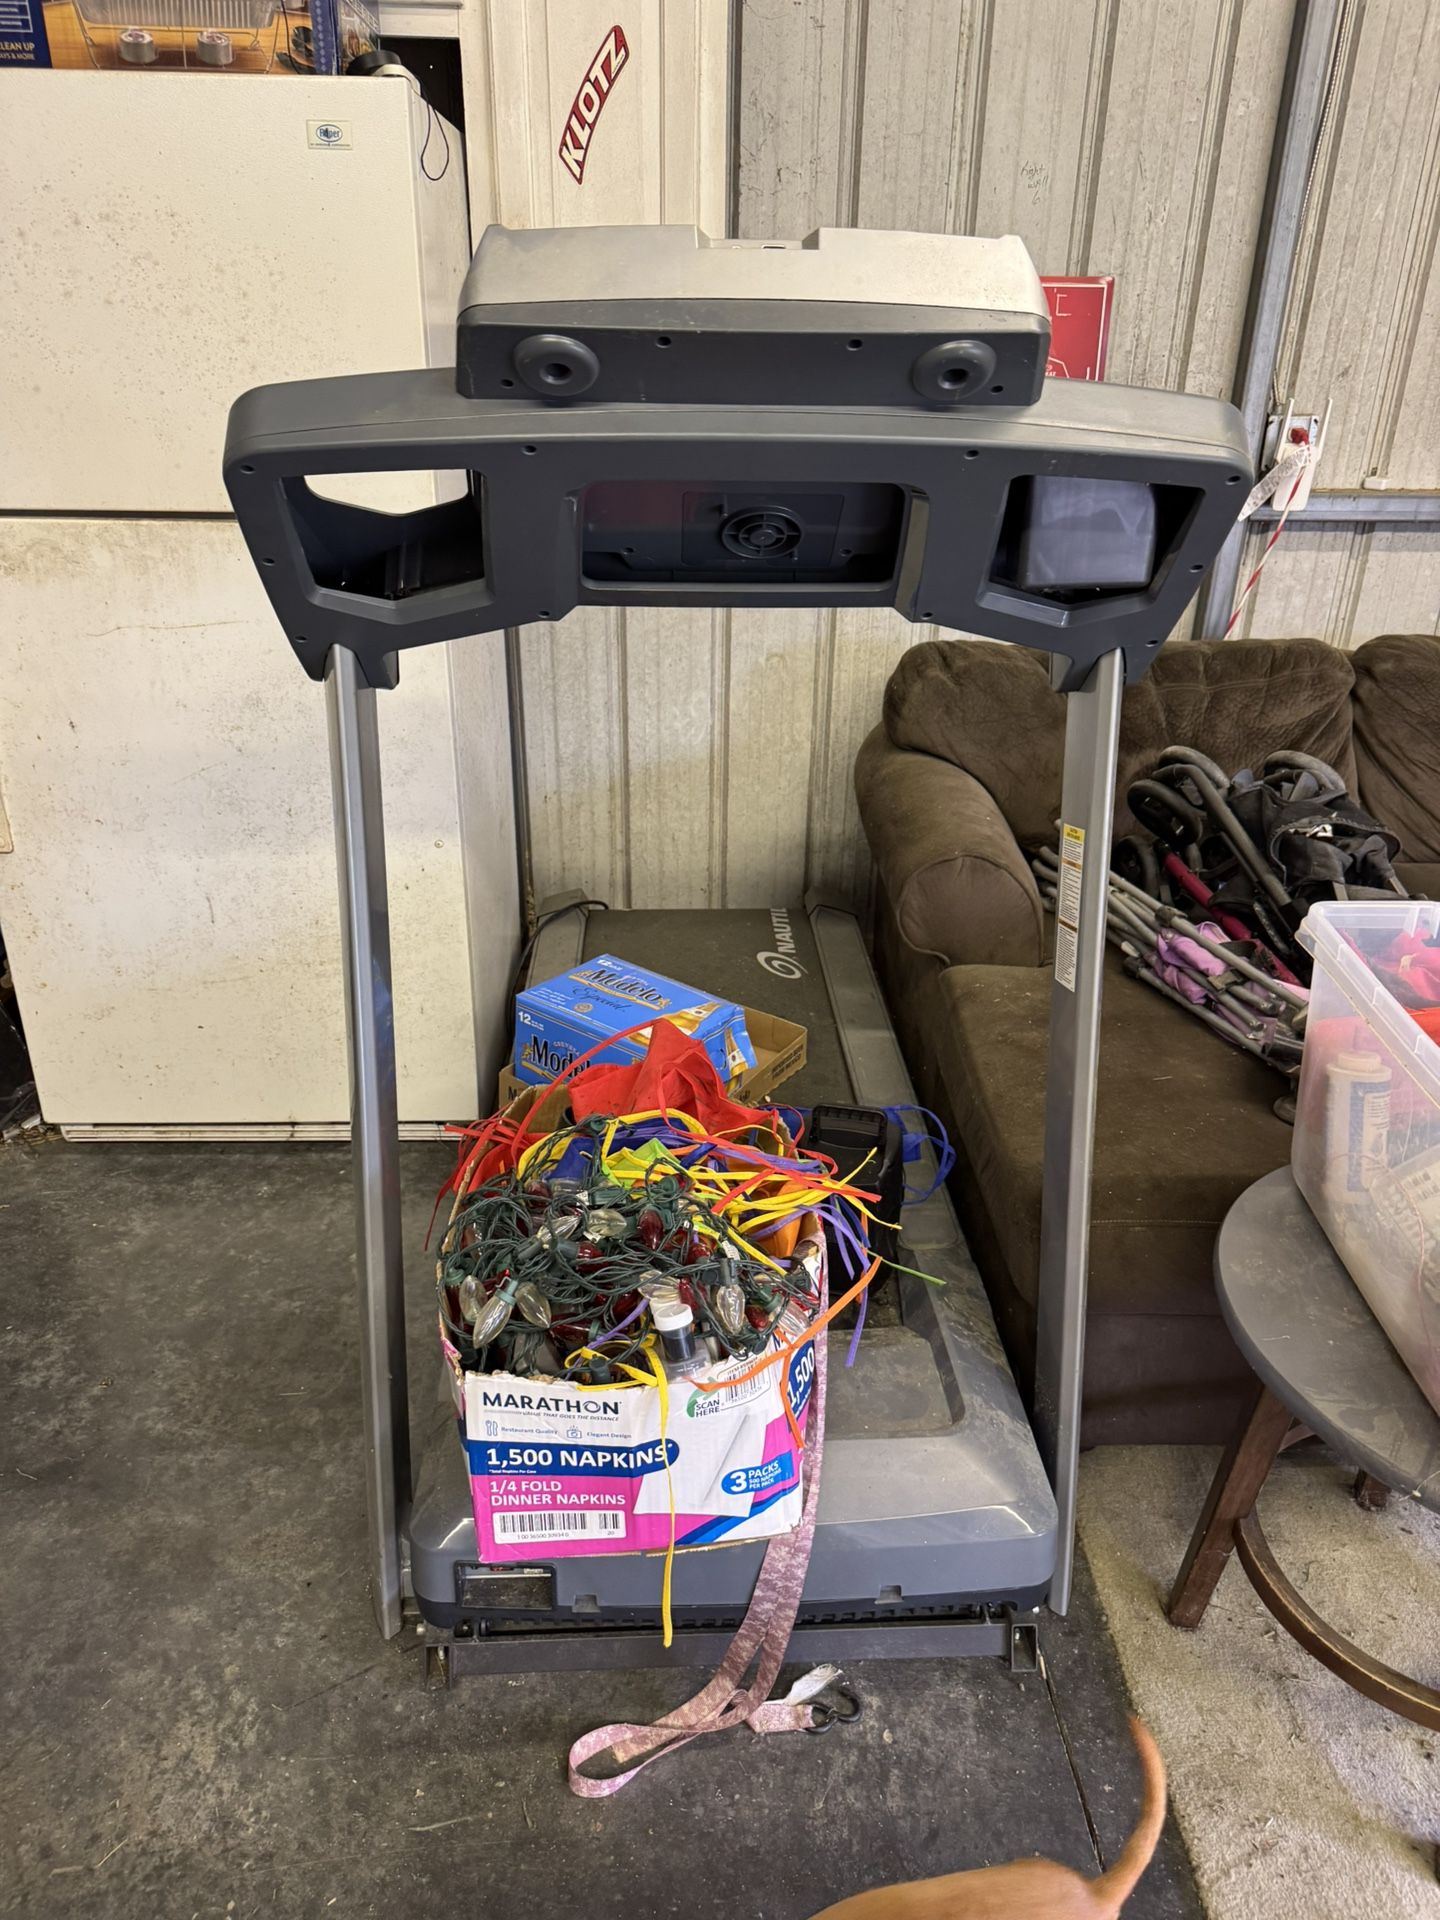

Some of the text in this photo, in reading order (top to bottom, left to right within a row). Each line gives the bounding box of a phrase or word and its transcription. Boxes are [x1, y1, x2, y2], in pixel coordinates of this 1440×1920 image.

[0, 41, 35, 51] LEAN UP
[560, 30, 627, 179] KLOTZ
[589, 968, 662, 1002] Modelo
[518, 1011, 531, 1025] 12
[787, 1346, 816, 1409] 1,500
[482, 1391, 620, 1415] MARATHON
[695, 1399, 720, 1411] SCAN
[695, 1406, 720, 1418] HERE
[501, 1426, 558, 1436] Restaurant Quality
[586, 1431, 632, 1440] Elegant Design
[486, 1448, 553, 1468] 1,500
[729, 1460, 779, 1492] 3 PACKS
[489, 1480, 563, 1493] 1/4 FOLD
[490, 1494, 626, 1507] DINNER NAPKINS
